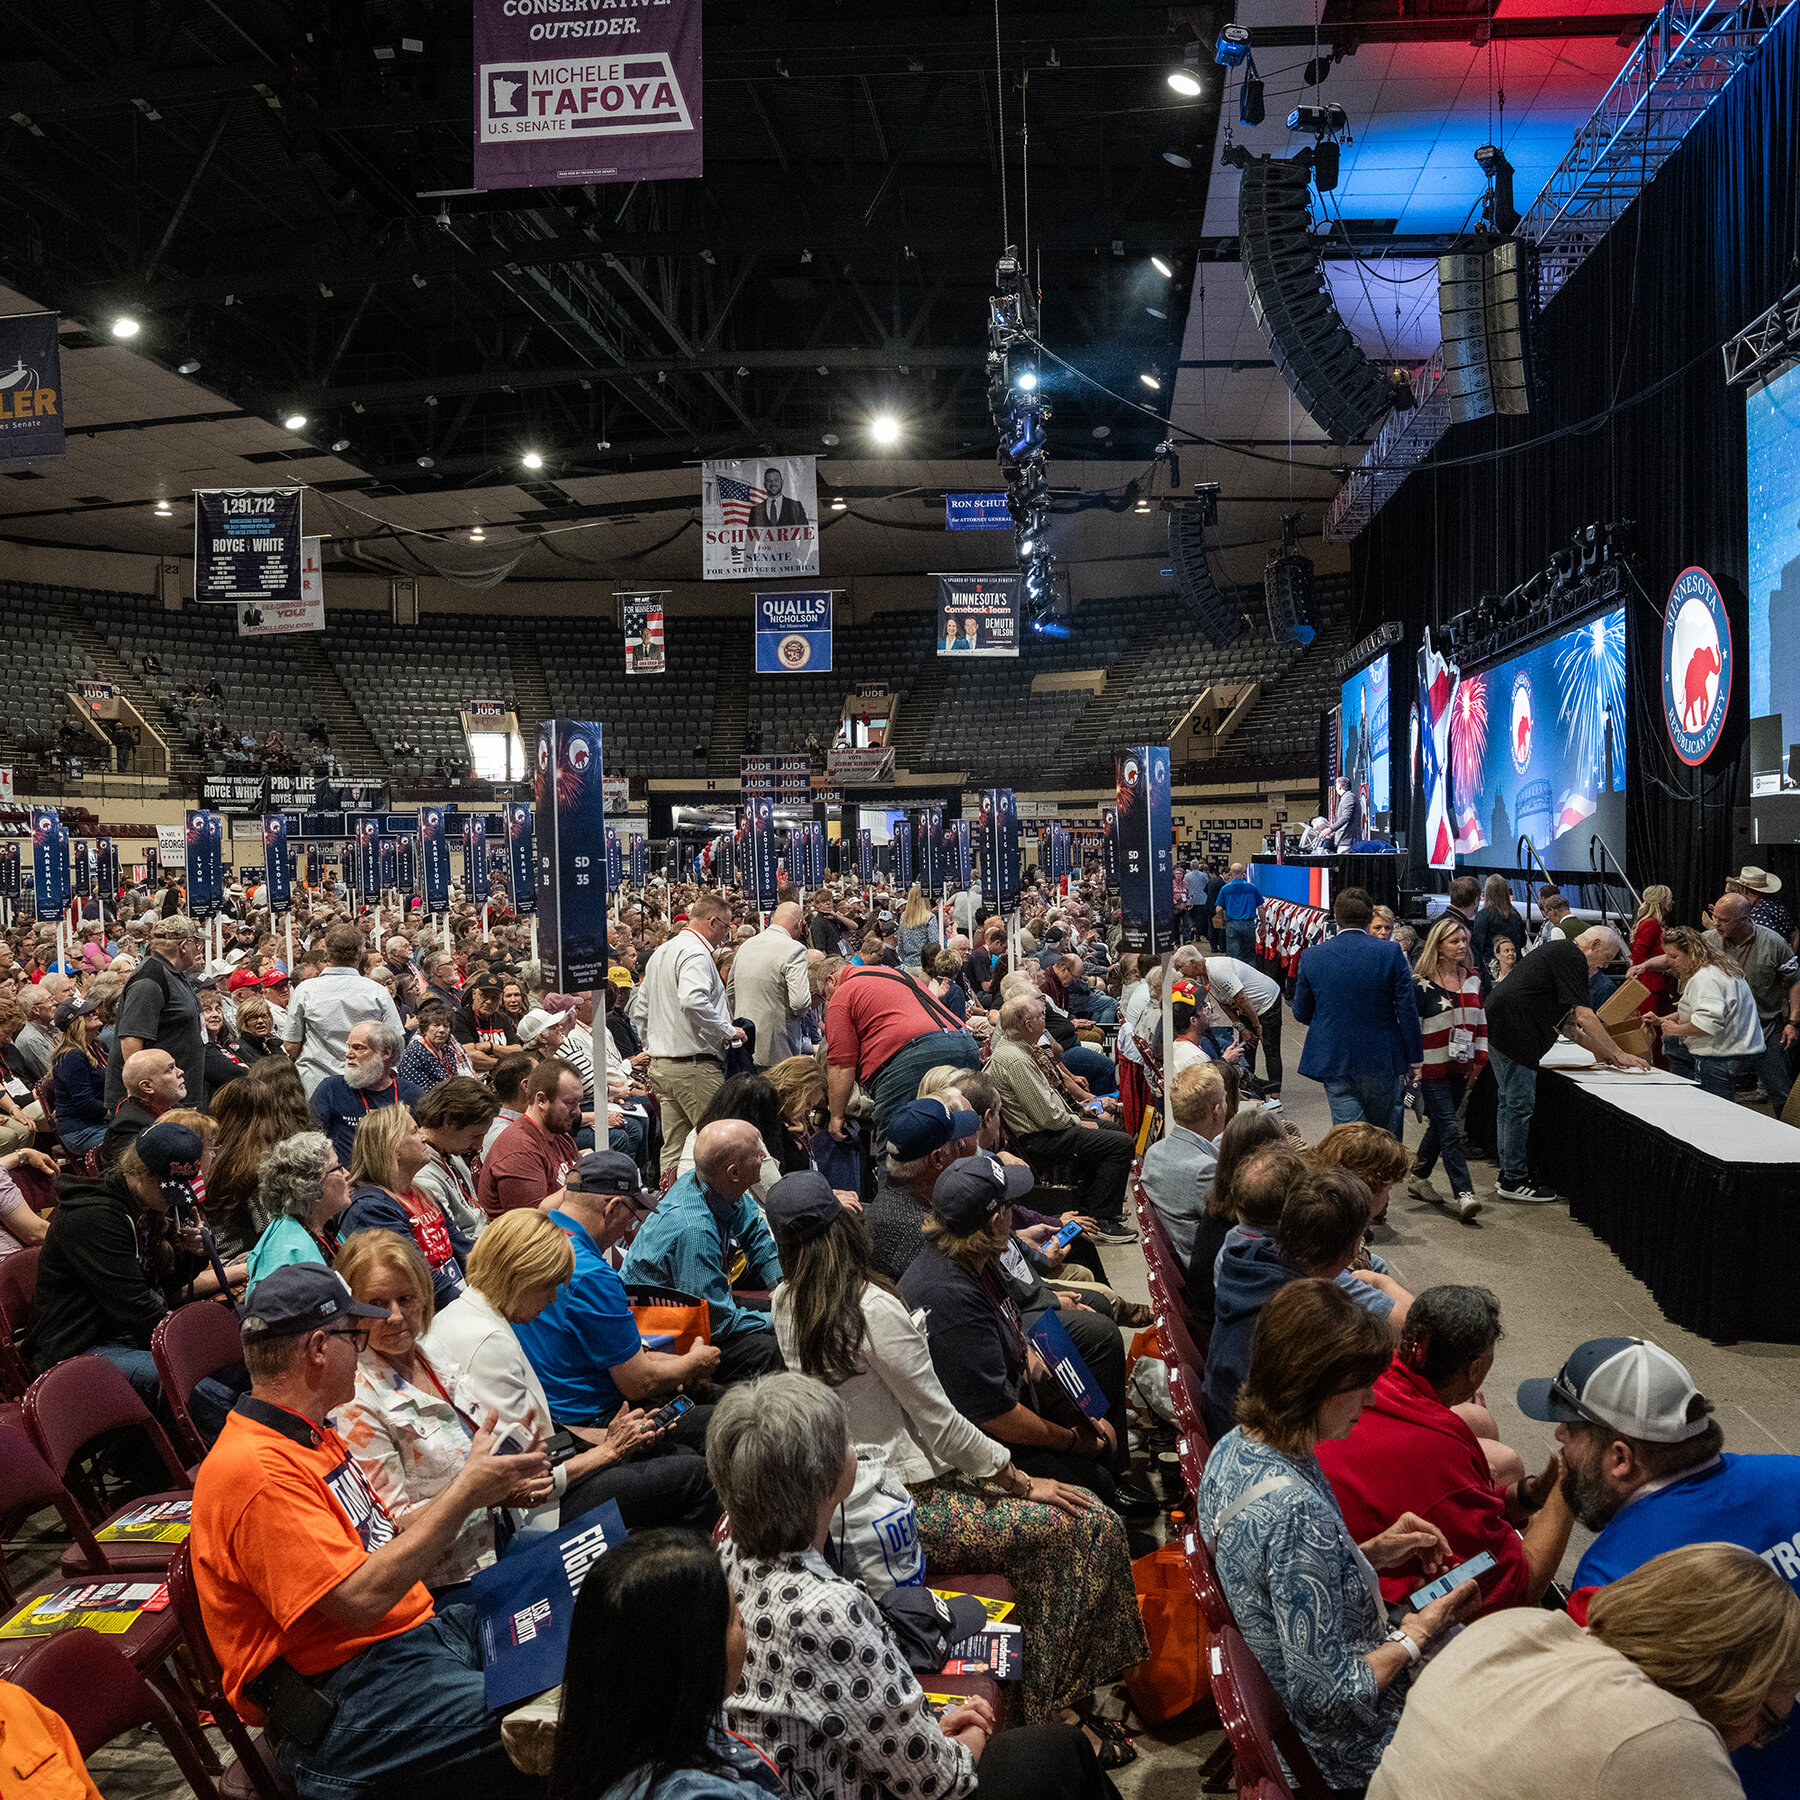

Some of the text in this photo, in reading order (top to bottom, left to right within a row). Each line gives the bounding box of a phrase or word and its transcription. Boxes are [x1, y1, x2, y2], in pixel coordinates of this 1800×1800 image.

[503, 0, 671, 16] CONSERVA.
[530, 17, 641, 41] OUTSIDER.
[533, 65, 620, 86] MICHELE
[532, 82, 677, 116] TAFOYA
[488, 119, 566, 135] U.S. SENATE
[13, 420, 41, 429] Senate
[222, 498, 275, 515] 1,291,712
[951, 500, 972, 508] RON
[706, 527, 815, 545] SCHWARZE
[213, 538, 284, 553] ROYCE WHITE
[746, 552, 791, 562] SENATE
[165, 564, 179, 575] 23
[733, 566, 776, 574] STRONGER
[779, 564, 816, 572] AMERICA
[398, 581, 412, 590] 25
[952, 593, 1007, 605] MINNESOTA'S
[1666, 575, 1717, 633] MINNESOTA
[635, 604, 663, 613] MINNESOTA
[762, 599, 825, 616] QUALLS
[944, 605, 1011, 613] Comeback Team
[770, 614, 818, 623] NICHOLSON
[985, 618, 1014, 628] DEMUTH
[992, 628, 1014, 637] WILSON
[83, 689, 109, 699] JUDE
[1192, 716, 1211, 736] 24
[1668, 690, 1725, 754] REPUBLICAN PARTY
[781, 762, 806, 770] JUDE
[271, 777, 290, 789] PRO
[295, 776, 315, 790] LIFE
[707, 781, 715, 790] H
[781, 779, 806, 787] JUDE
[204, 785, 262, 799] ROYCE WHITE
[271, 794, 316, 804] ROYCE WHITE
[781, 796, 806, 804] JUDE
[1186, 826, 1193, 836] F
[161, 840, 184, 848] GEORGE
[1128, 850, 1139, 860] SD
[1158, 850, 1166, 859] SD
[542, 857, 550, 868] SD
[574, 856, 590, 868] SD
[43, 846, 52, 898] MARSHALL
[274, 847, 282, 890] LINCOLN
[1129, 863, 1139, 873] 34
[543, 874, 550, 886] 35
[576, 874, 590, 886] 35
[530, 1597, 551, 1622] LISA
[514, 1606, 537, 1645] DEMUTH
[995, 1634, 1011, 1677] Leadership
